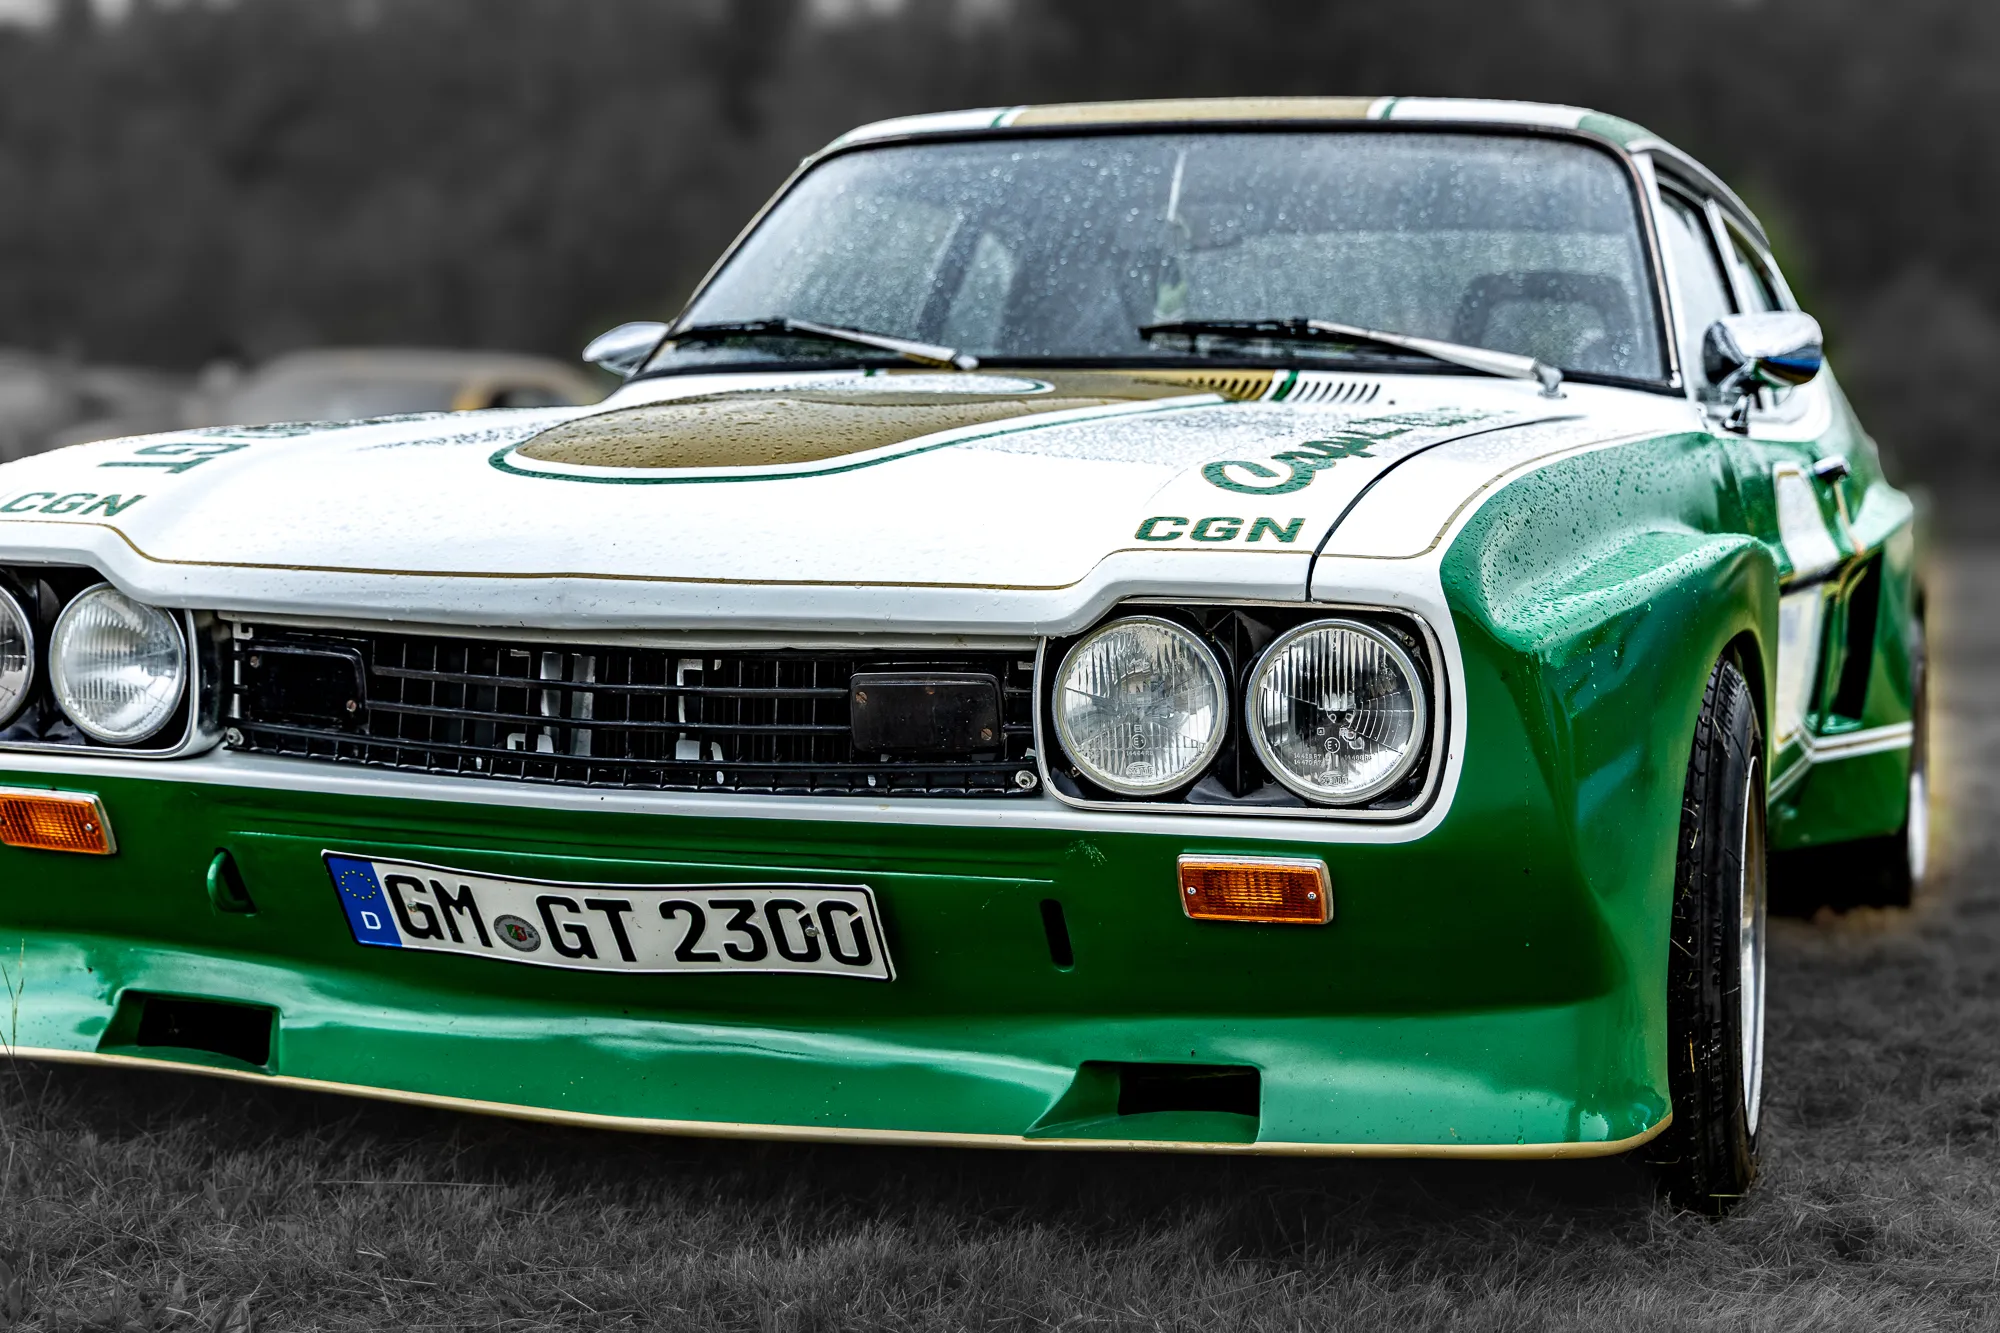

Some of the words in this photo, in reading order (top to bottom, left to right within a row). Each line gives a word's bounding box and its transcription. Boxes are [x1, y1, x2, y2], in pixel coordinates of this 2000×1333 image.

[0, 491, 147, 517] CGN
[1135, 516, 1306, 544] CGN
[360, 911, 382, 930] D
[384, 874, 493, 948] GM
[535, 894, 639, 963] GT
[658, 898, 875, 967] 2300
